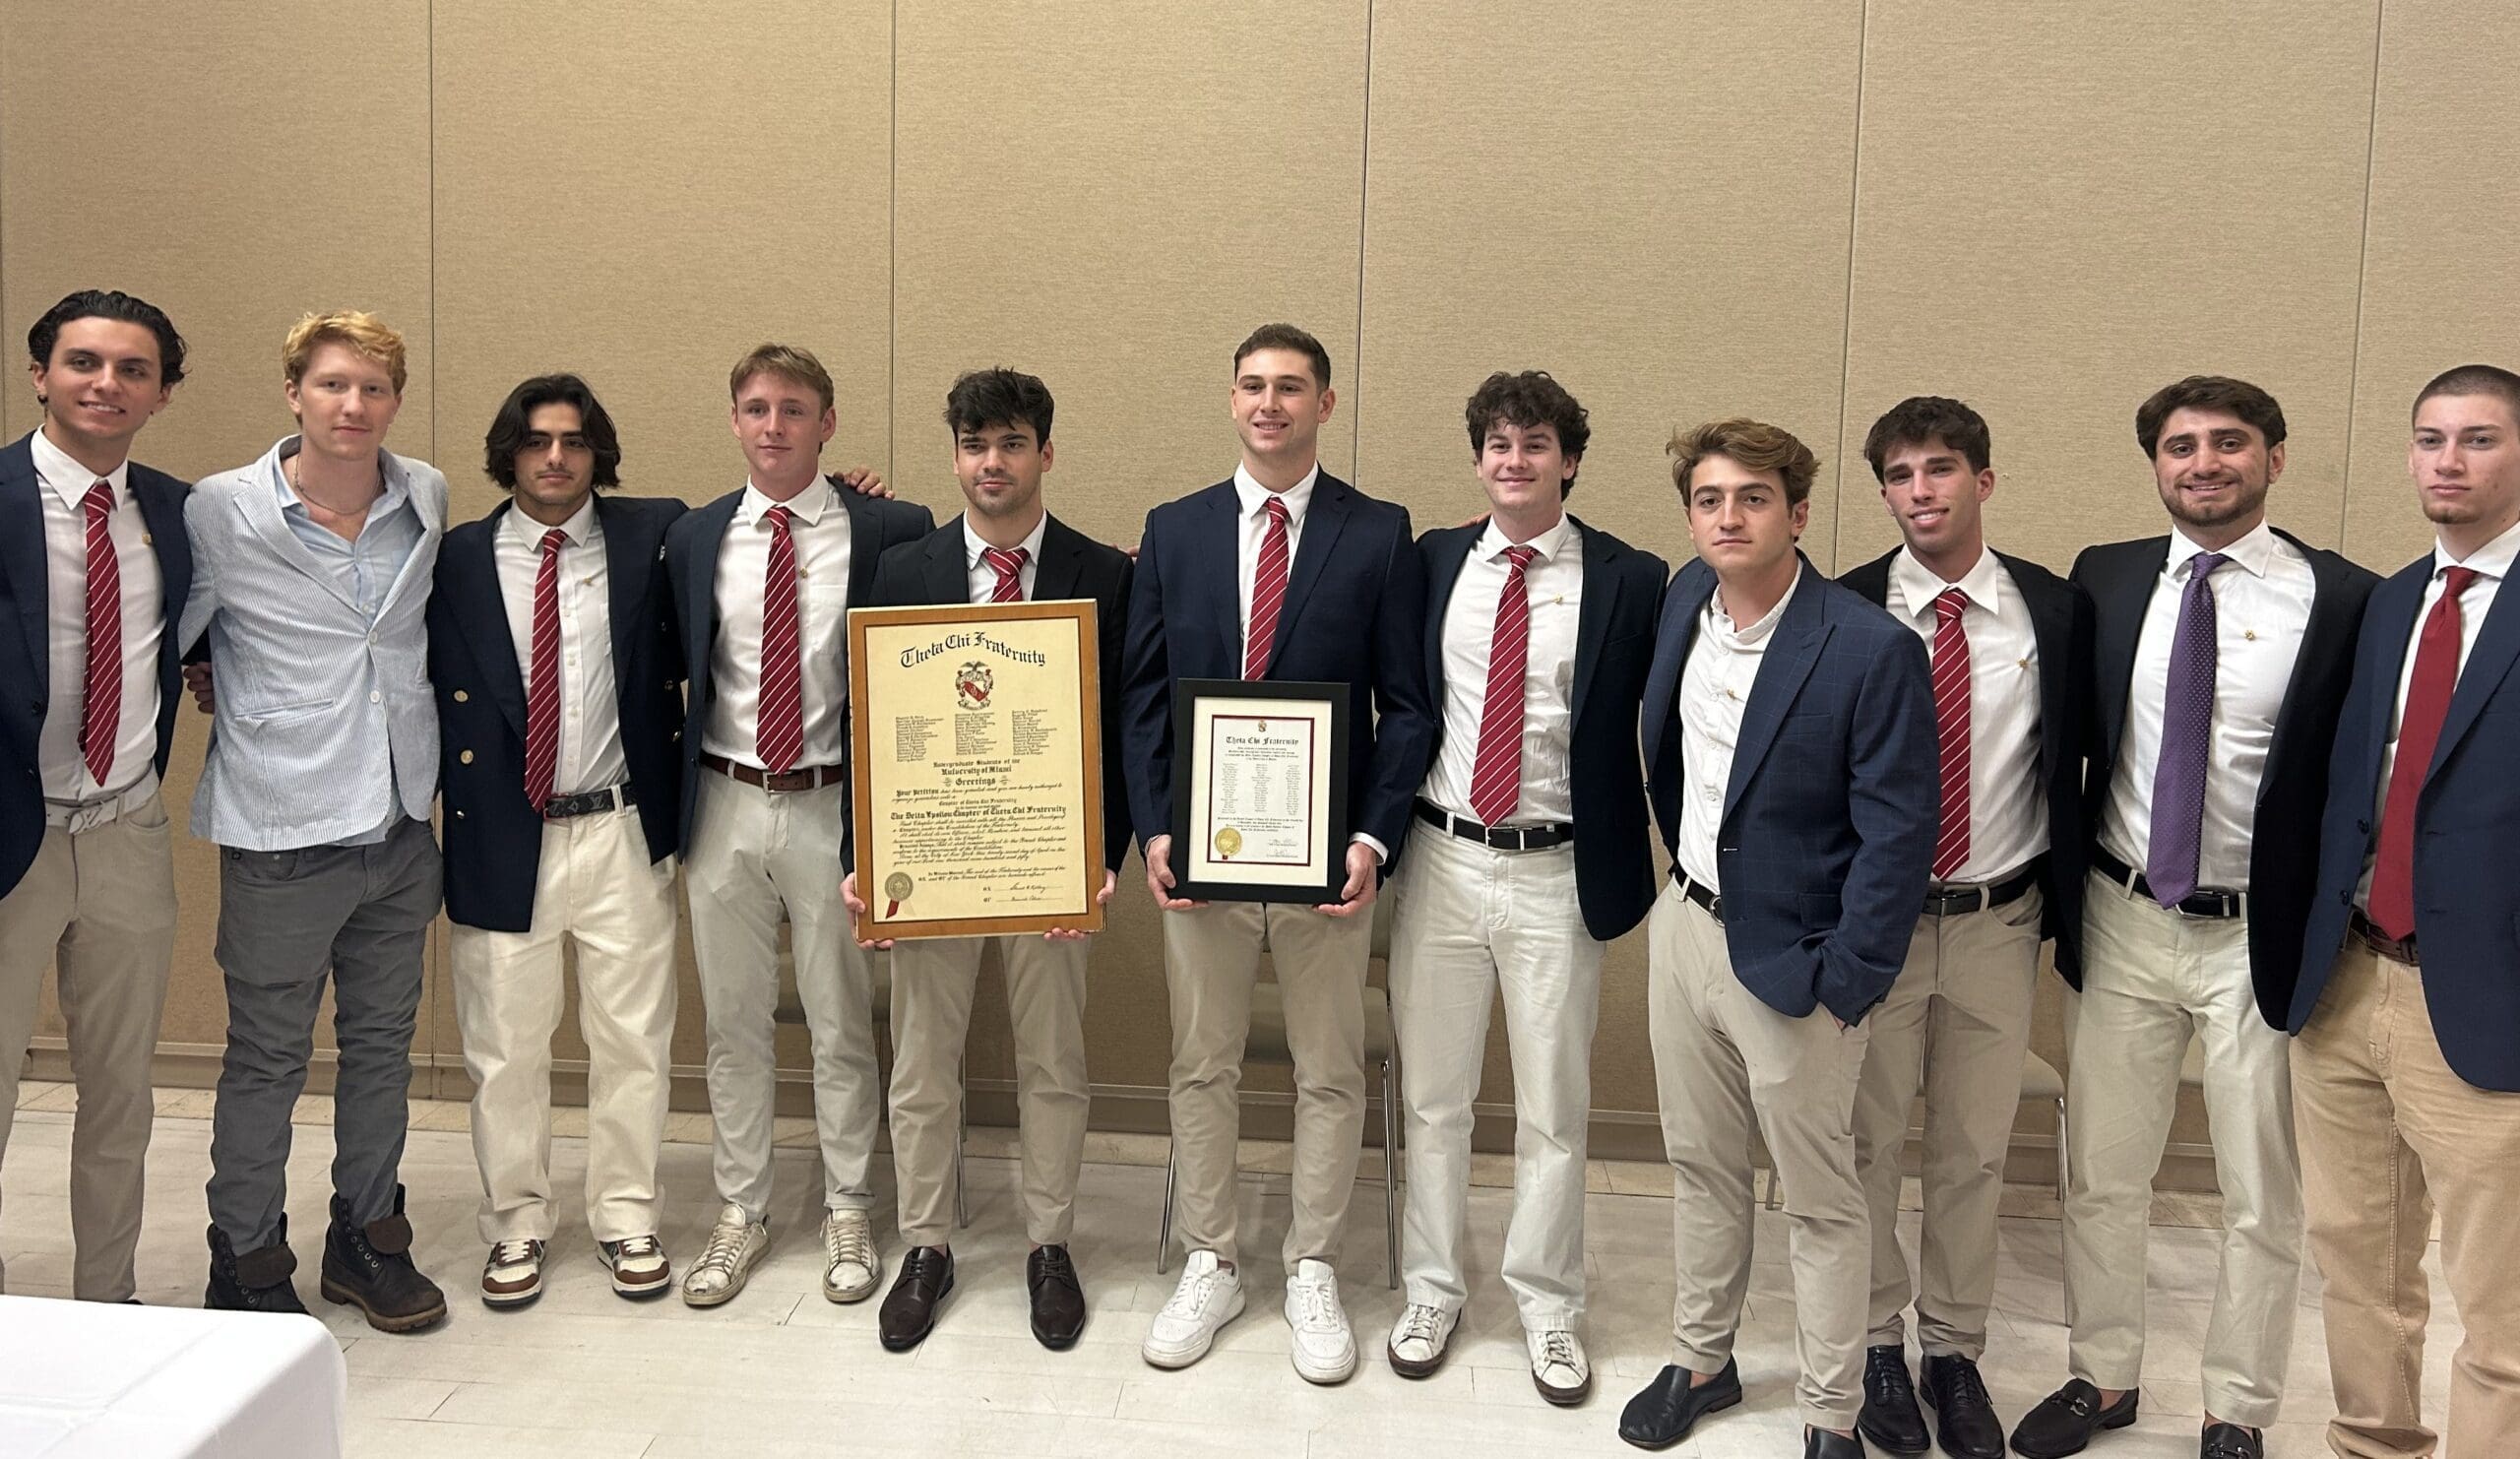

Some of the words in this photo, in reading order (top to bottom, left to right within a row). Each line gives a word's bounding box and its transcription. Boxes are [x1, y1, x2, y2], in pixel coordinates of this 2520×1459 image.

[900, 642, 944, 668] Theta
[945, 633, 971, 649] Chi
[974, 631, 1046, 666] Fraternity
[1226, 736, 1246, 744] Theta
[1262, 736, 1299, 745] Fraternity
[941, 767, 980, 776] University
[989, 765, 1012, 773] Miami
[955, 777, 996, 786] Greetings
[952, 809, 982, 818] Chapter
[990, 807, 1011, 815] Theta
[1026, 805, 1067, 816] Fraternity
